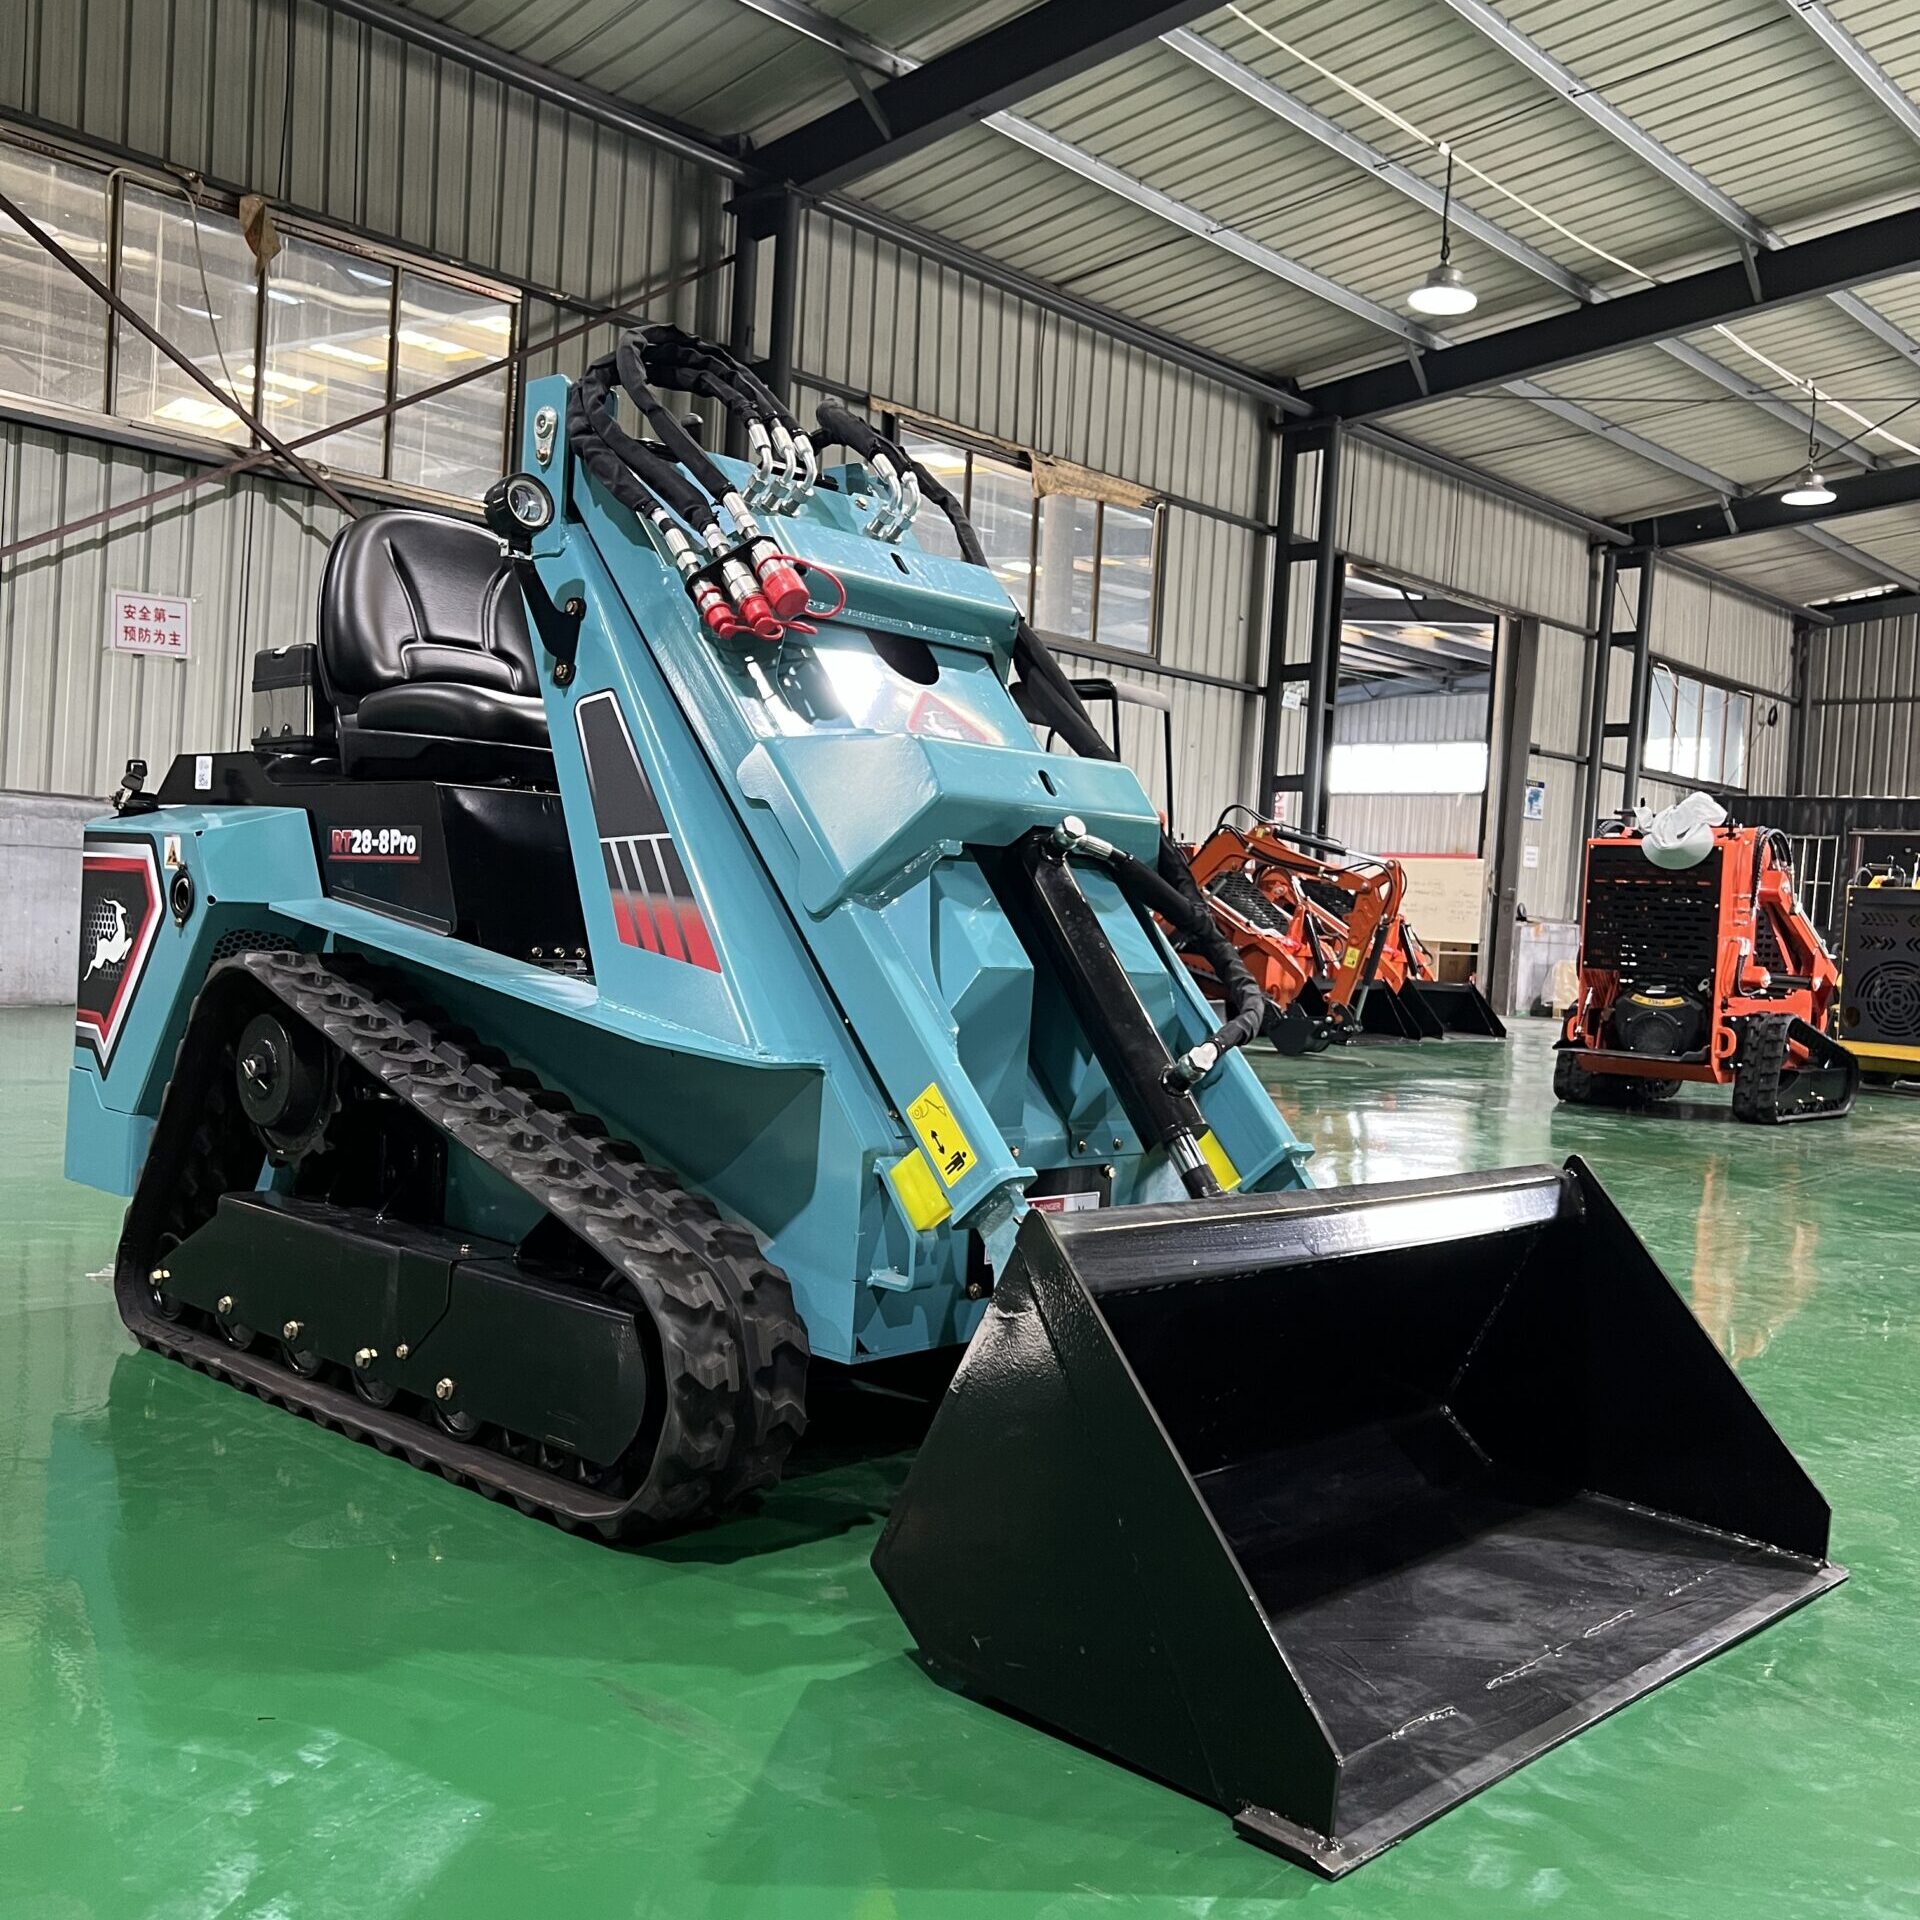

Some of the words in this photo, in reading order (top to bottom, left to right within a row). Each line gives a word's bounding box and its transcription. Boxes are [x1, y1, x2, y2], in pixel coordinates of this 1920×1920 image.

[123, 604, 181, 622] 安全第一
[123, 625, 181, 646] 预防为主
[331, 829, 416, 854] RT28-8Pro
